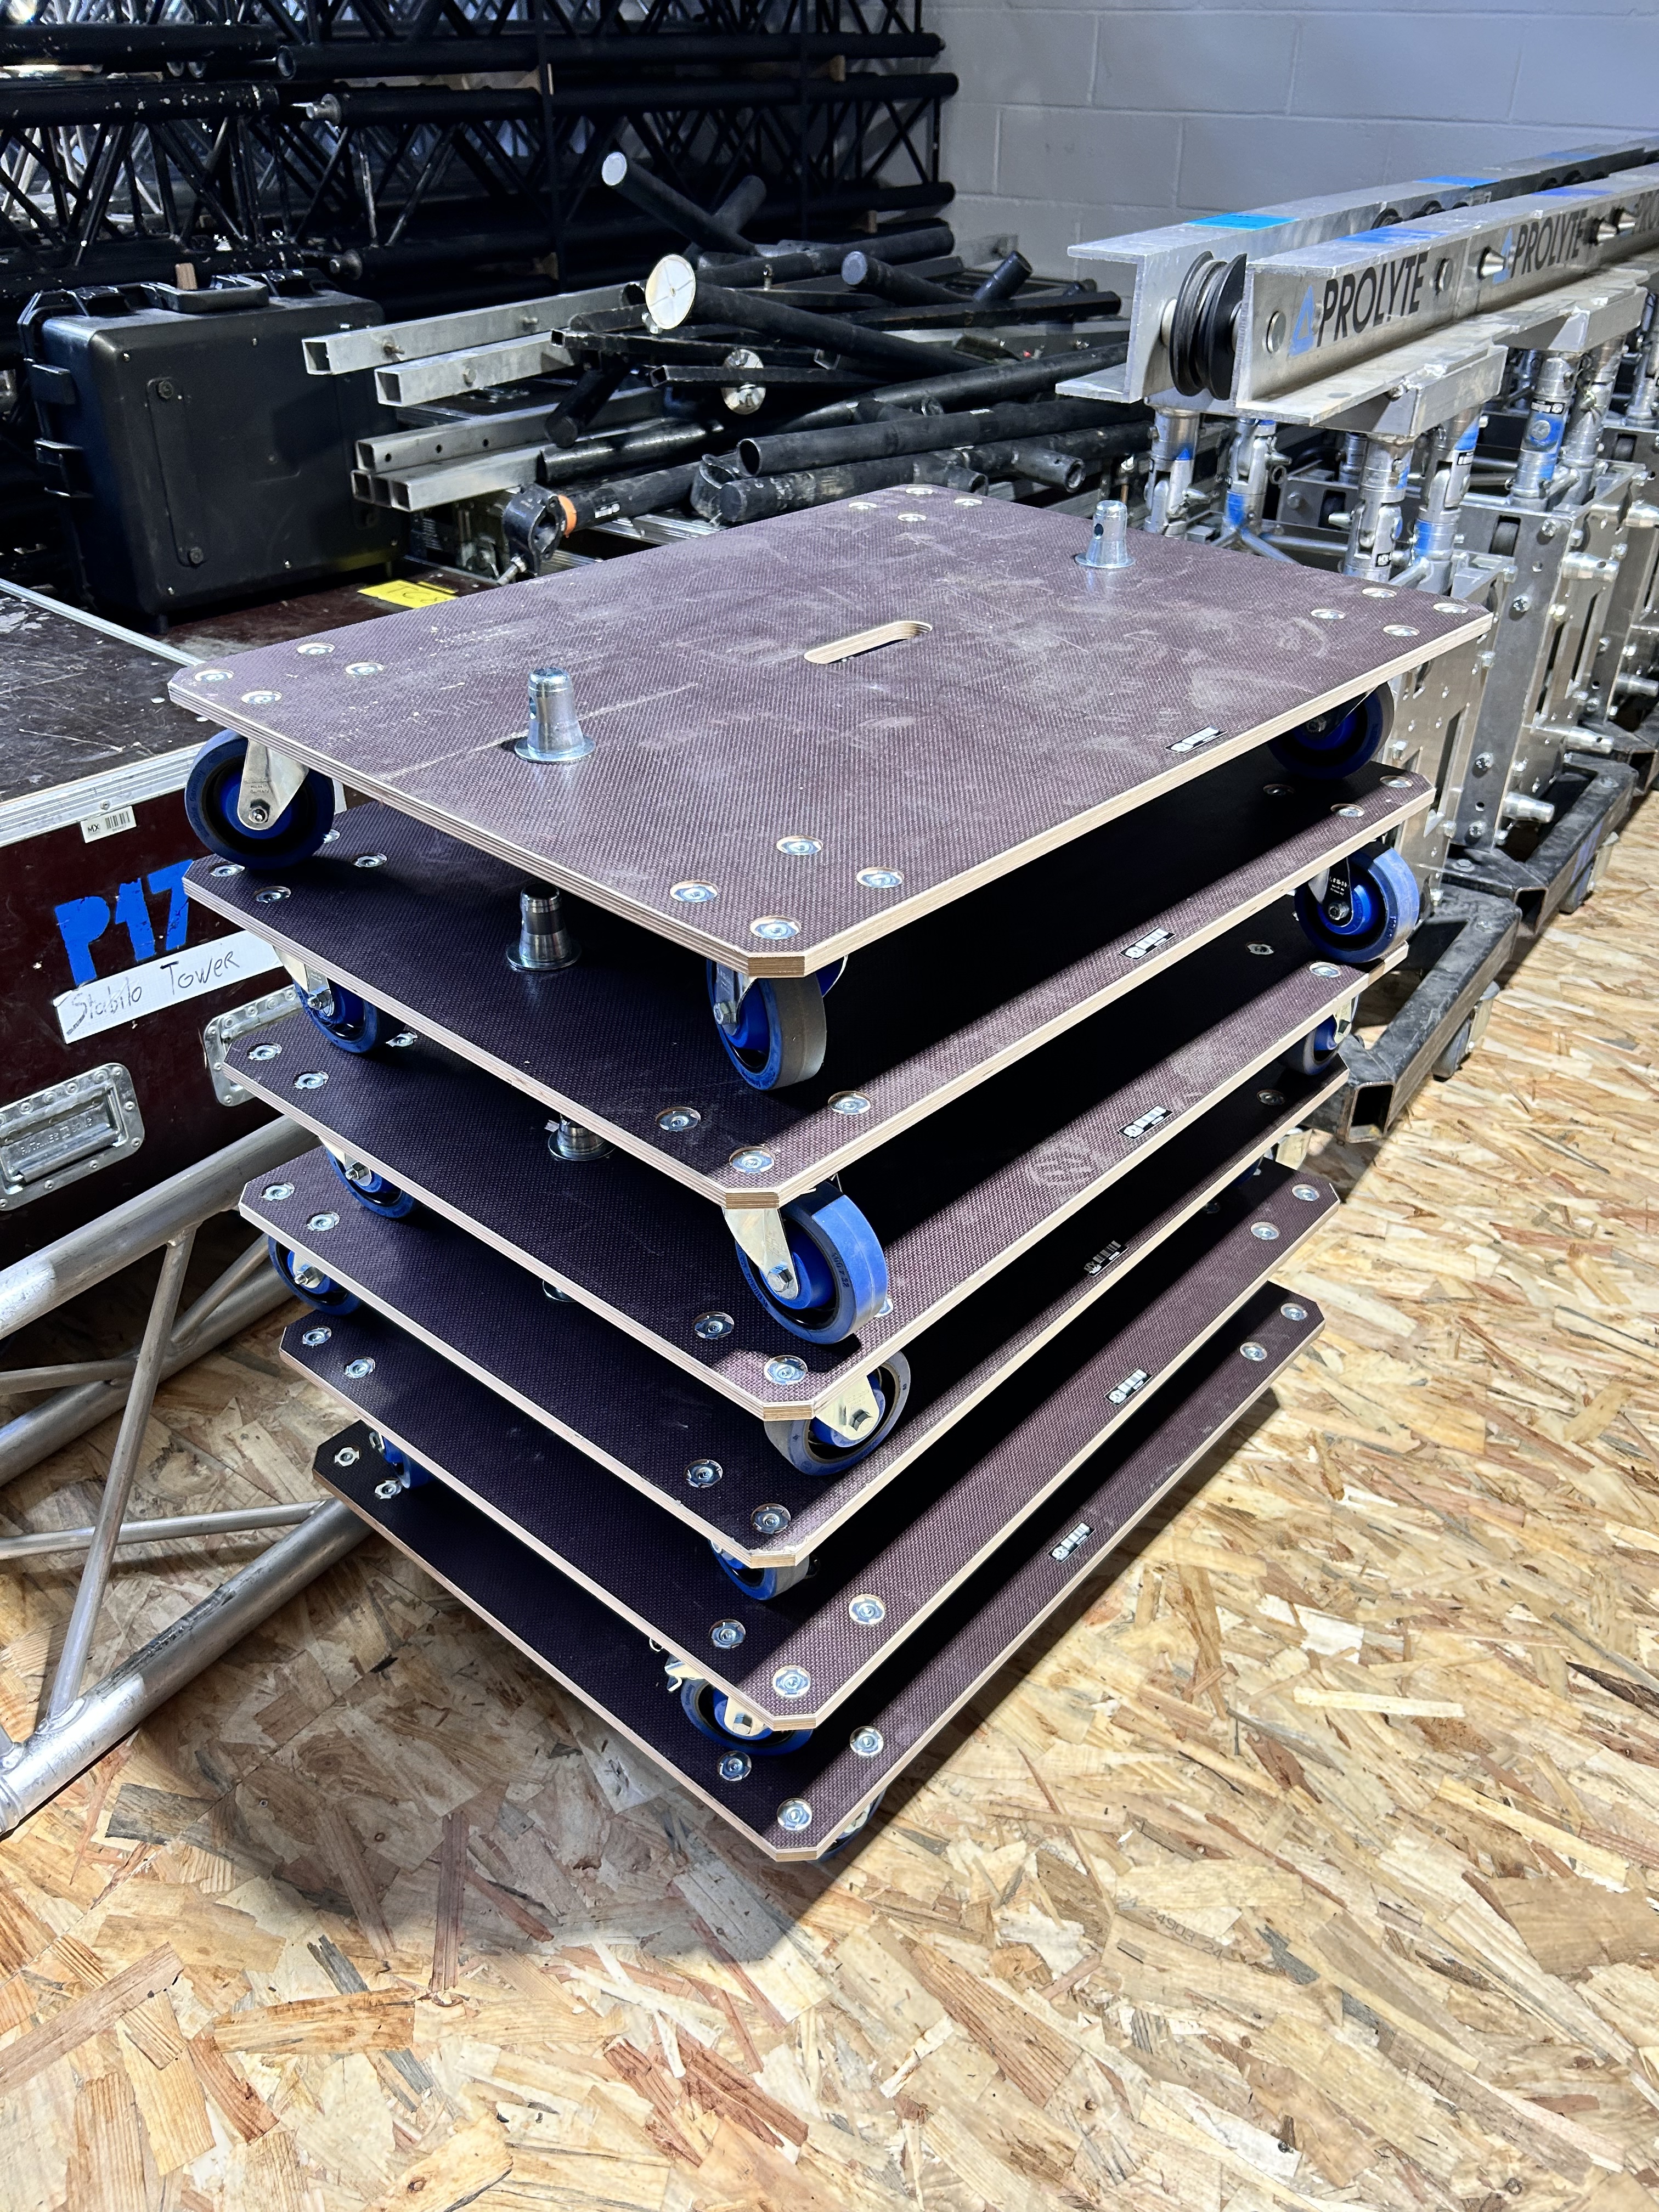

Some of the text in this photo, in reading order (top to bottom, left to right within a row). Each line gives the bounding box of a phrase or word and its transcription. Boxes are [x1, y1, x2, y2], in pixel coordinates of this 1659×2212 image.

[1510, 208, 1588, 279] PROLYTE
[1317, 251, 1429, 347] PROLYTE
[54, 860, 193, 987] P17
